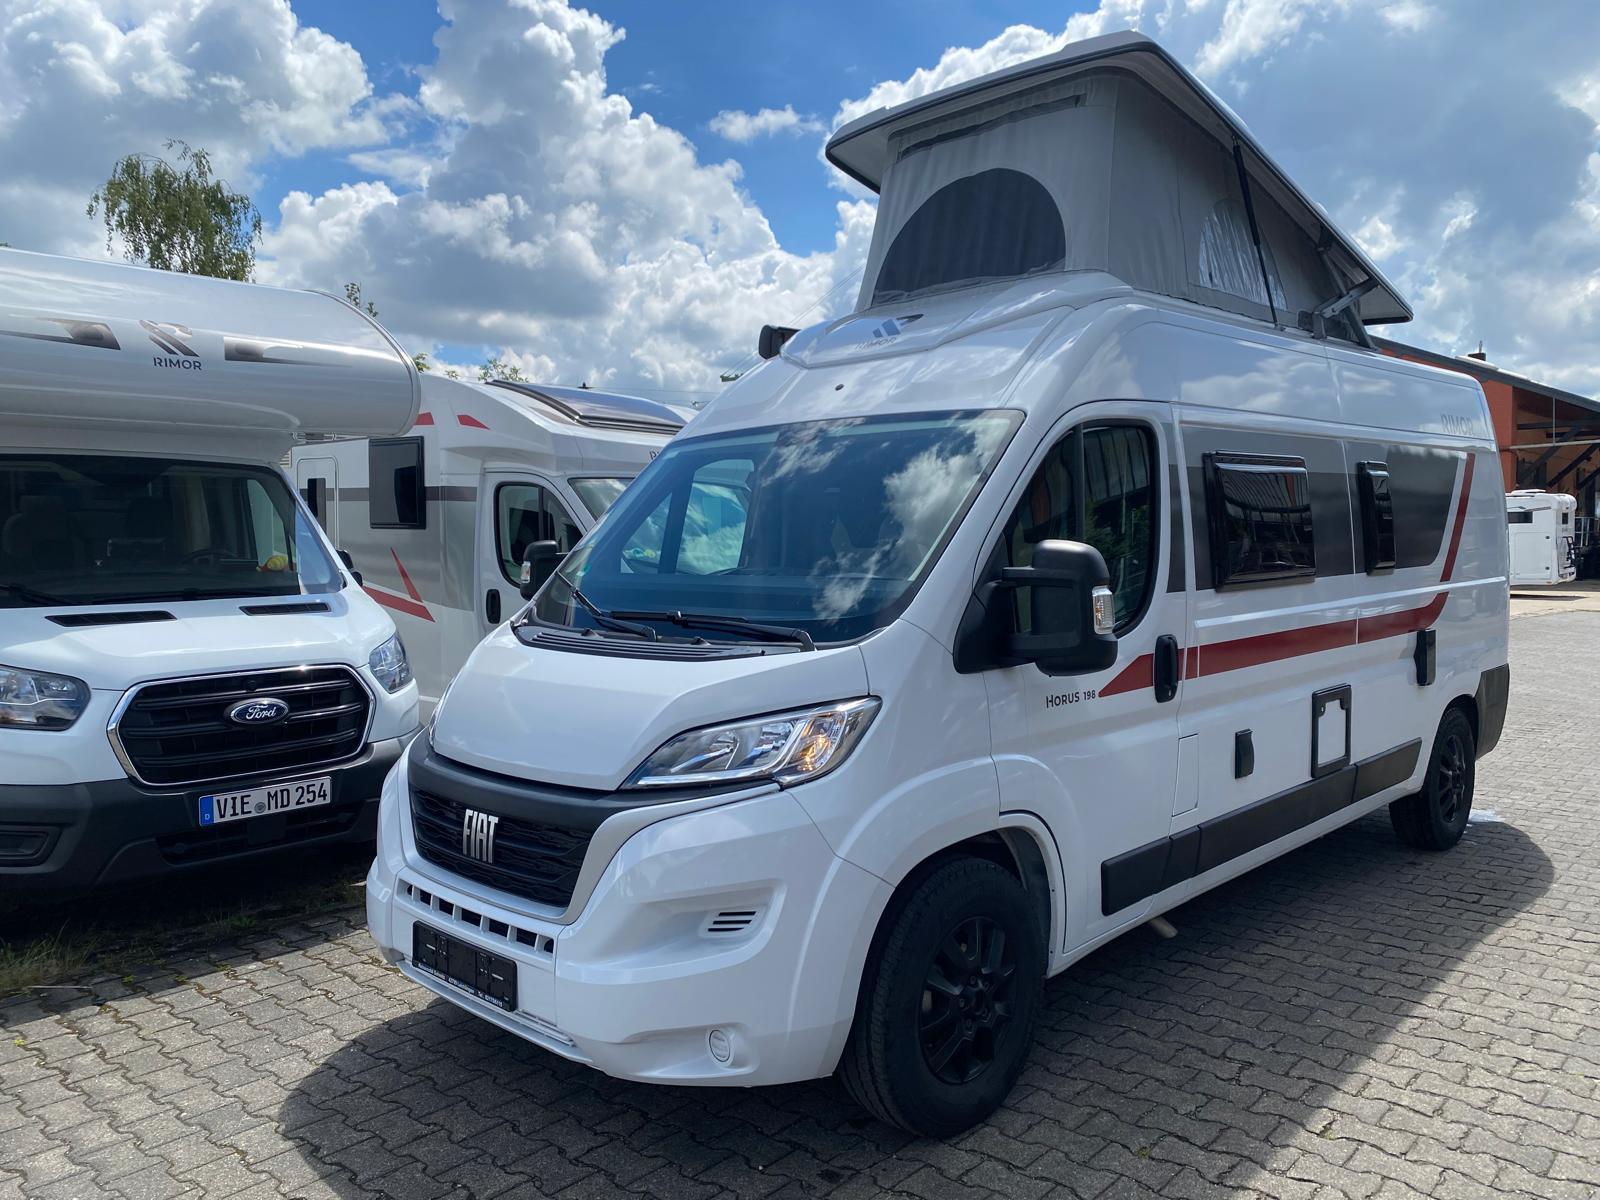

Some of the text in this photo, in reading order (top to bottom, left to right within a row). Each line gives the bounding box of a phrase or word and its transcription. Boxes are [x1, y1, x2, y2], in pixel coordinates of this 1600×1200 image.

[153, 357, 202, 371] RIMOR
[1045, 689, 1096, 709] HORUS 198
[245, 704, 277, 720] Ford
[216, 782, 328, 819] VIE MD 254
[463, 808, 499, 864] FIAT
